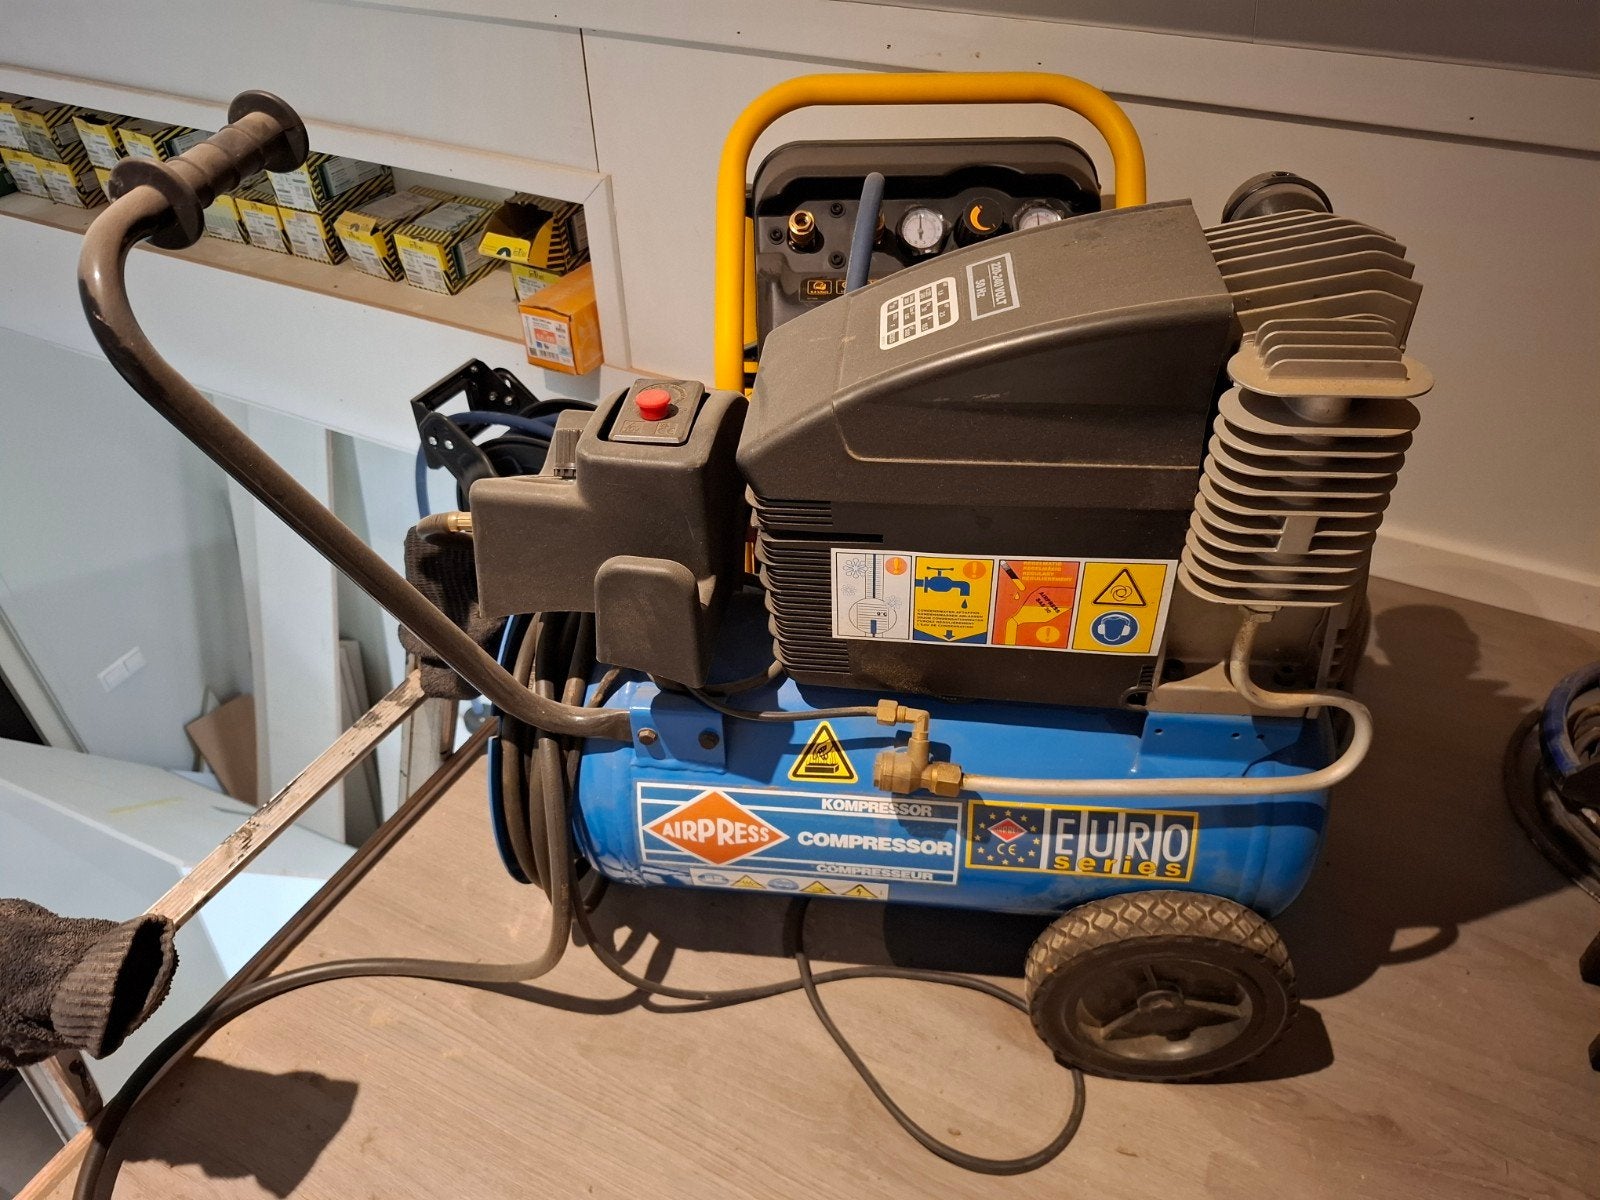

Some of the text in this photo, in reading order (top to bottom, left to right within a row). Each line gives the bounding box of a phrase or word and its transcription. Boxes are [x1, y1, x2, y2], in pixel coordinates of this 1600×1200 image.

[977, 287, 987, 298] Hz
[995, 287, 1007, 306] VOLT
[821, 798, 932, 818] KOMPRESSOR
[661, 818, 770, 847] AIRPRESS
[797, 830, 953, 856] COMPRESSOR
[1054, 818, 1189, 863] EURO
[816, 863, 934, 881] COMPRESSEUR
[1053, 855, 1182, 877] series
